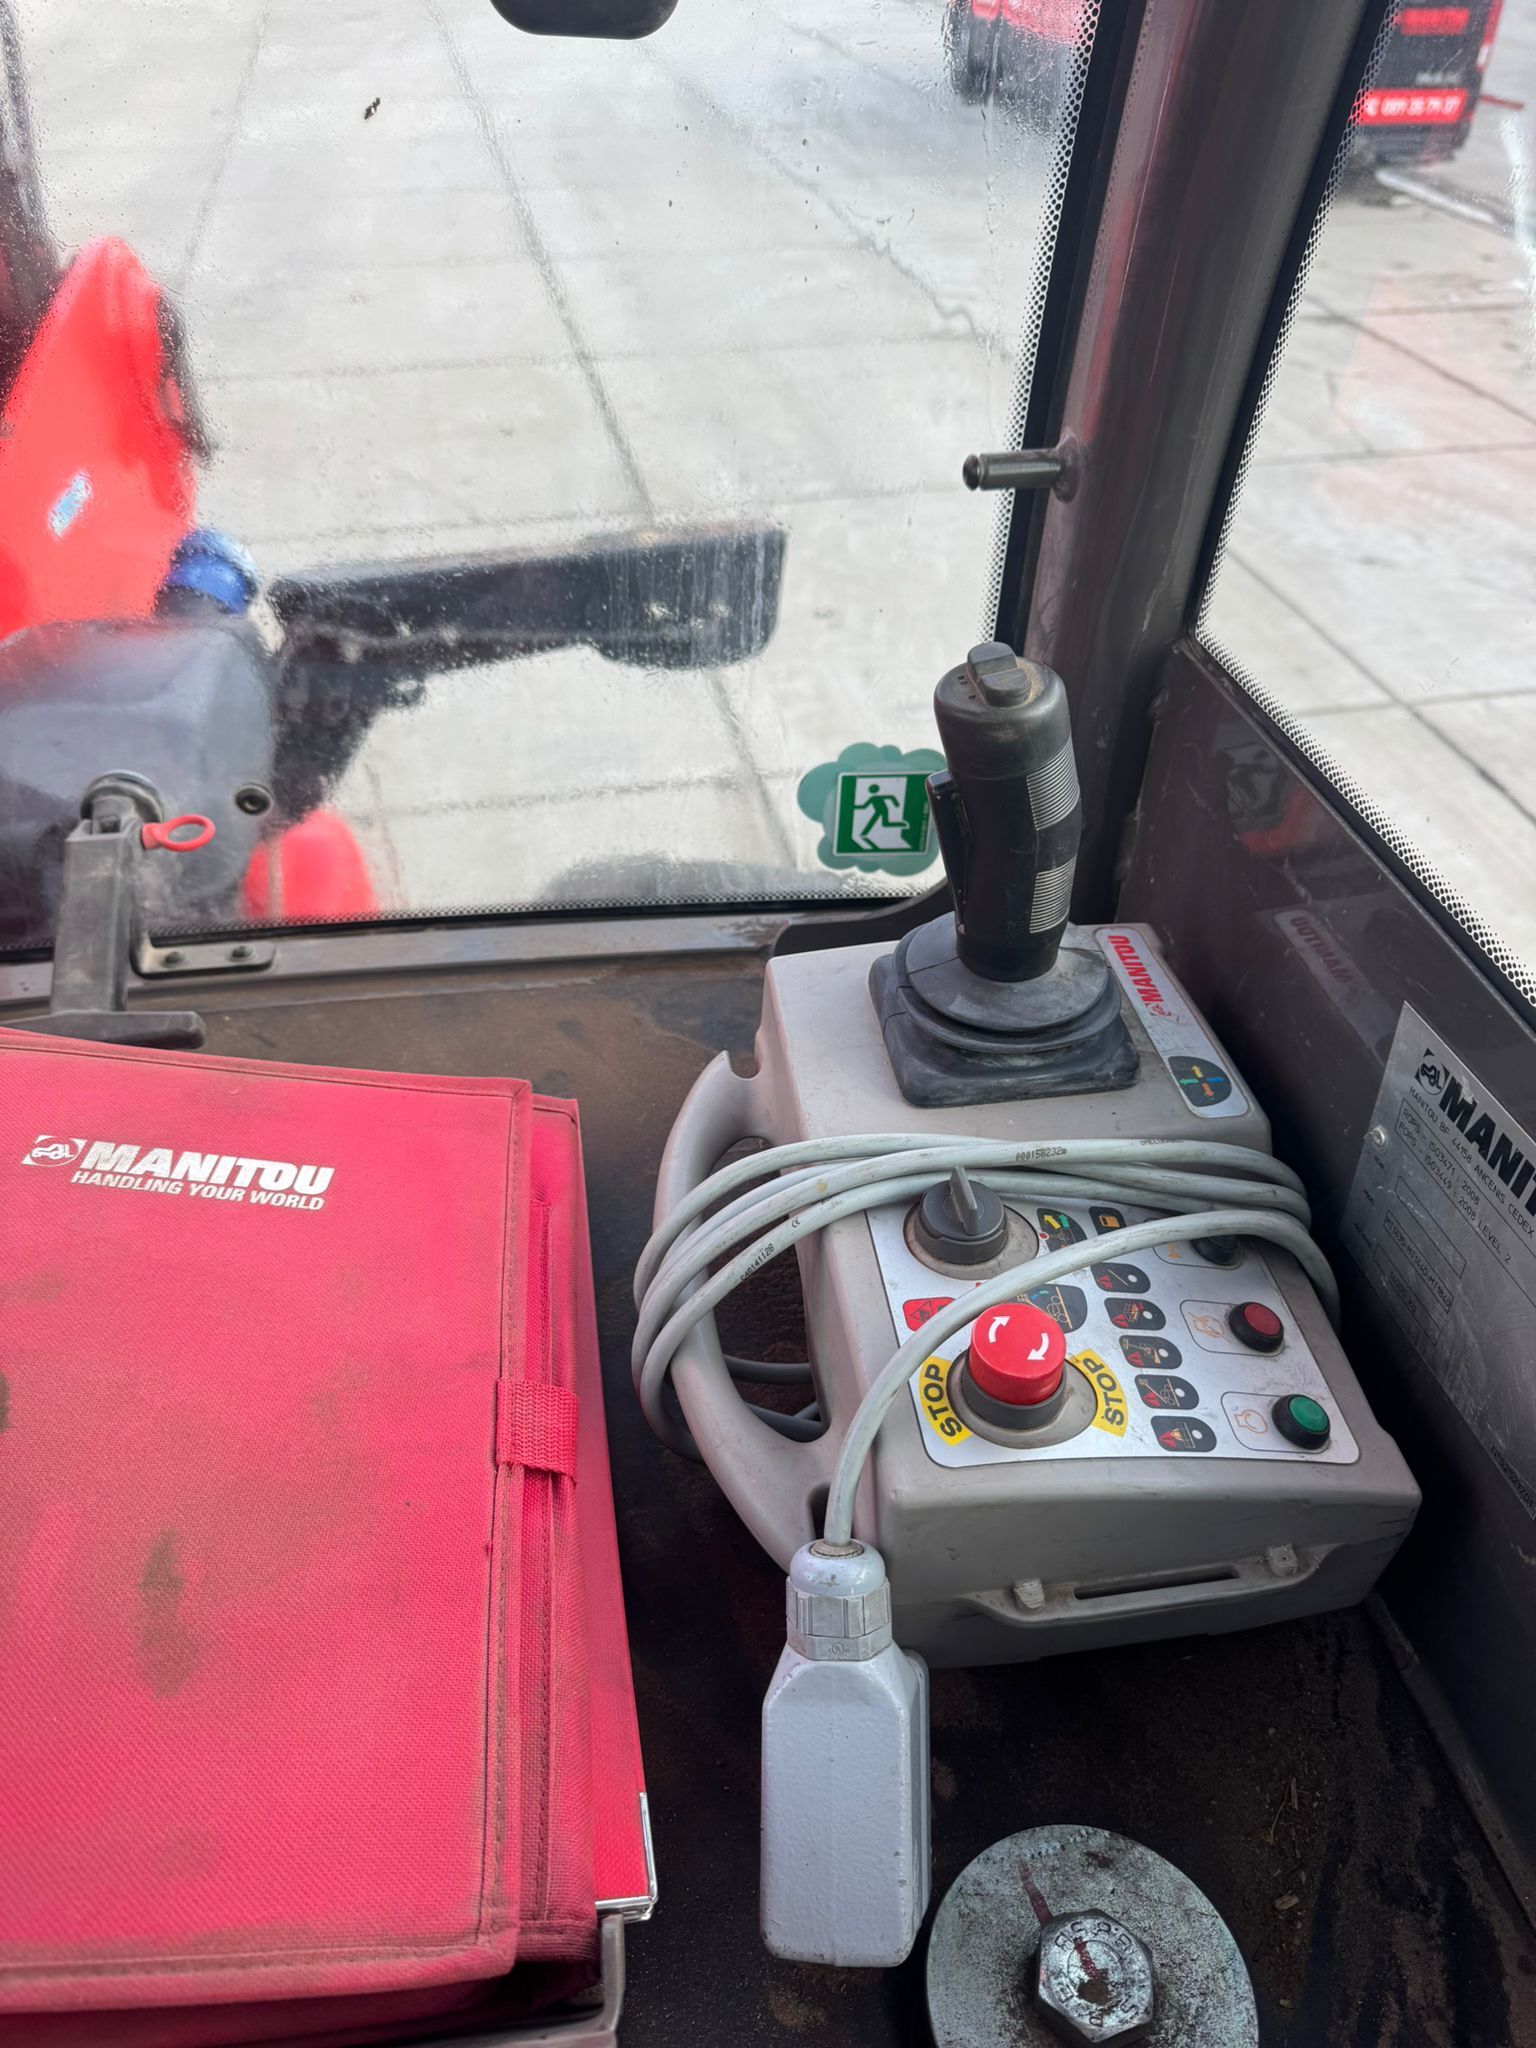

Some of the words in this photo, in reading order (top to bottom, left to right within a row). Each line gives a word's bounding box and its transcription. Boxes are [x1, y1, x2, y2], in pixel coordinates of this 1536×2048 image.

[1106, 935, 1164, 1002] MANITOU
[70, 1170, 183, 1195] HANDLING
[187, 1183, 245, 1203] YOUR
[249, 1191, 326, 1211] WORLD
[80, 1140, 335, 1196] MANITOU
[1399, 1121, 1417, 1147] FOPS
[1425, 1154, 1452, 1190] ISO3449
[1458, 1196, 1477, 1221] 2008
[1478, 1220, 1502, 1254] LEVEL
[1504, 1253, 1512, 1265] 2
[1403, 1108, 1420, 1134] ROPS
[1428, 1141, 1456, 1176] ISO3471
[1461, 1180, 1480, 1206] 2008
[1409, 1086, 1438, 1123] MANITOU
[1450, 1136, 1473, 1164] 44158
[1474, 1164, 1506, 1204] ANCENIS
[1508, 1203, 1535, 1239] CEDEX
[923, 1363, 963, 1438] STOP
[1082, 1356, 1125, 1426] STOP
